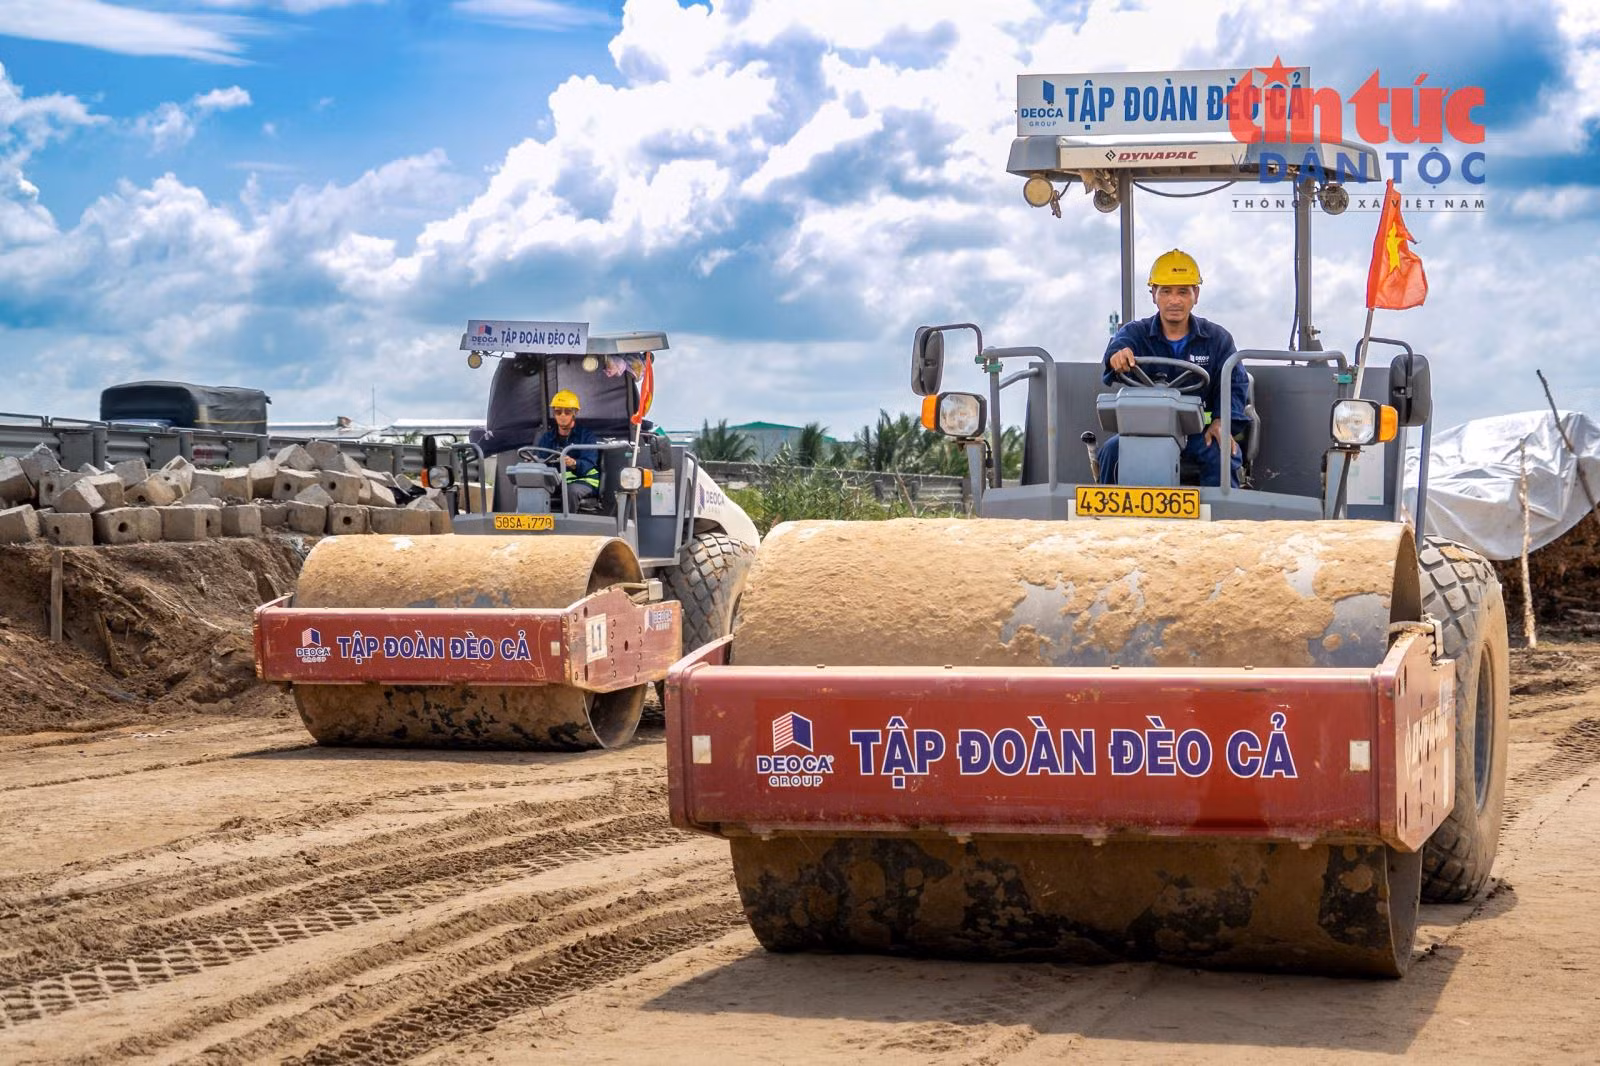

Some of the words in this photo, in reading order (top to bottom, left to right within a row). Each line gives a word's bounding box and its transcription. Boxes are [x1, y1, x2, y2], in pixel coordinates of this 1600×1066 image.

[1065, 79, 1114, 130] TẬP
[1123, 78, 1197, 122] ĐOÀN
[1207, 77, 1260, 121] ĐÈO
[1269, 71, 1305, 121] CẢ
[1021, 107, 1064, 119] DEOCA
[1118, 151, 1198, 161] DYNAPAC
[1080, 490, 1195, 515] 43SA-0365
[296, 647, 331, 657] DEOCA
[336, 630, 380, 664] TẬP
[383, 629, 445, 659] ĐOÀN
[449, 629, 495, 660] ĐÈO
[499, 629, 532, 661] CẢ
[849, 715, 946, 789] TẬP
[956, 715, 1096, 776] ĐOÀN
[1108, 715, 1213, 778] ĐÈO
[1226, 711, 1298, 778] CẢ
[756, 754, 834, 774] DEOCA
[768, 775, 824, 787] GROUP
